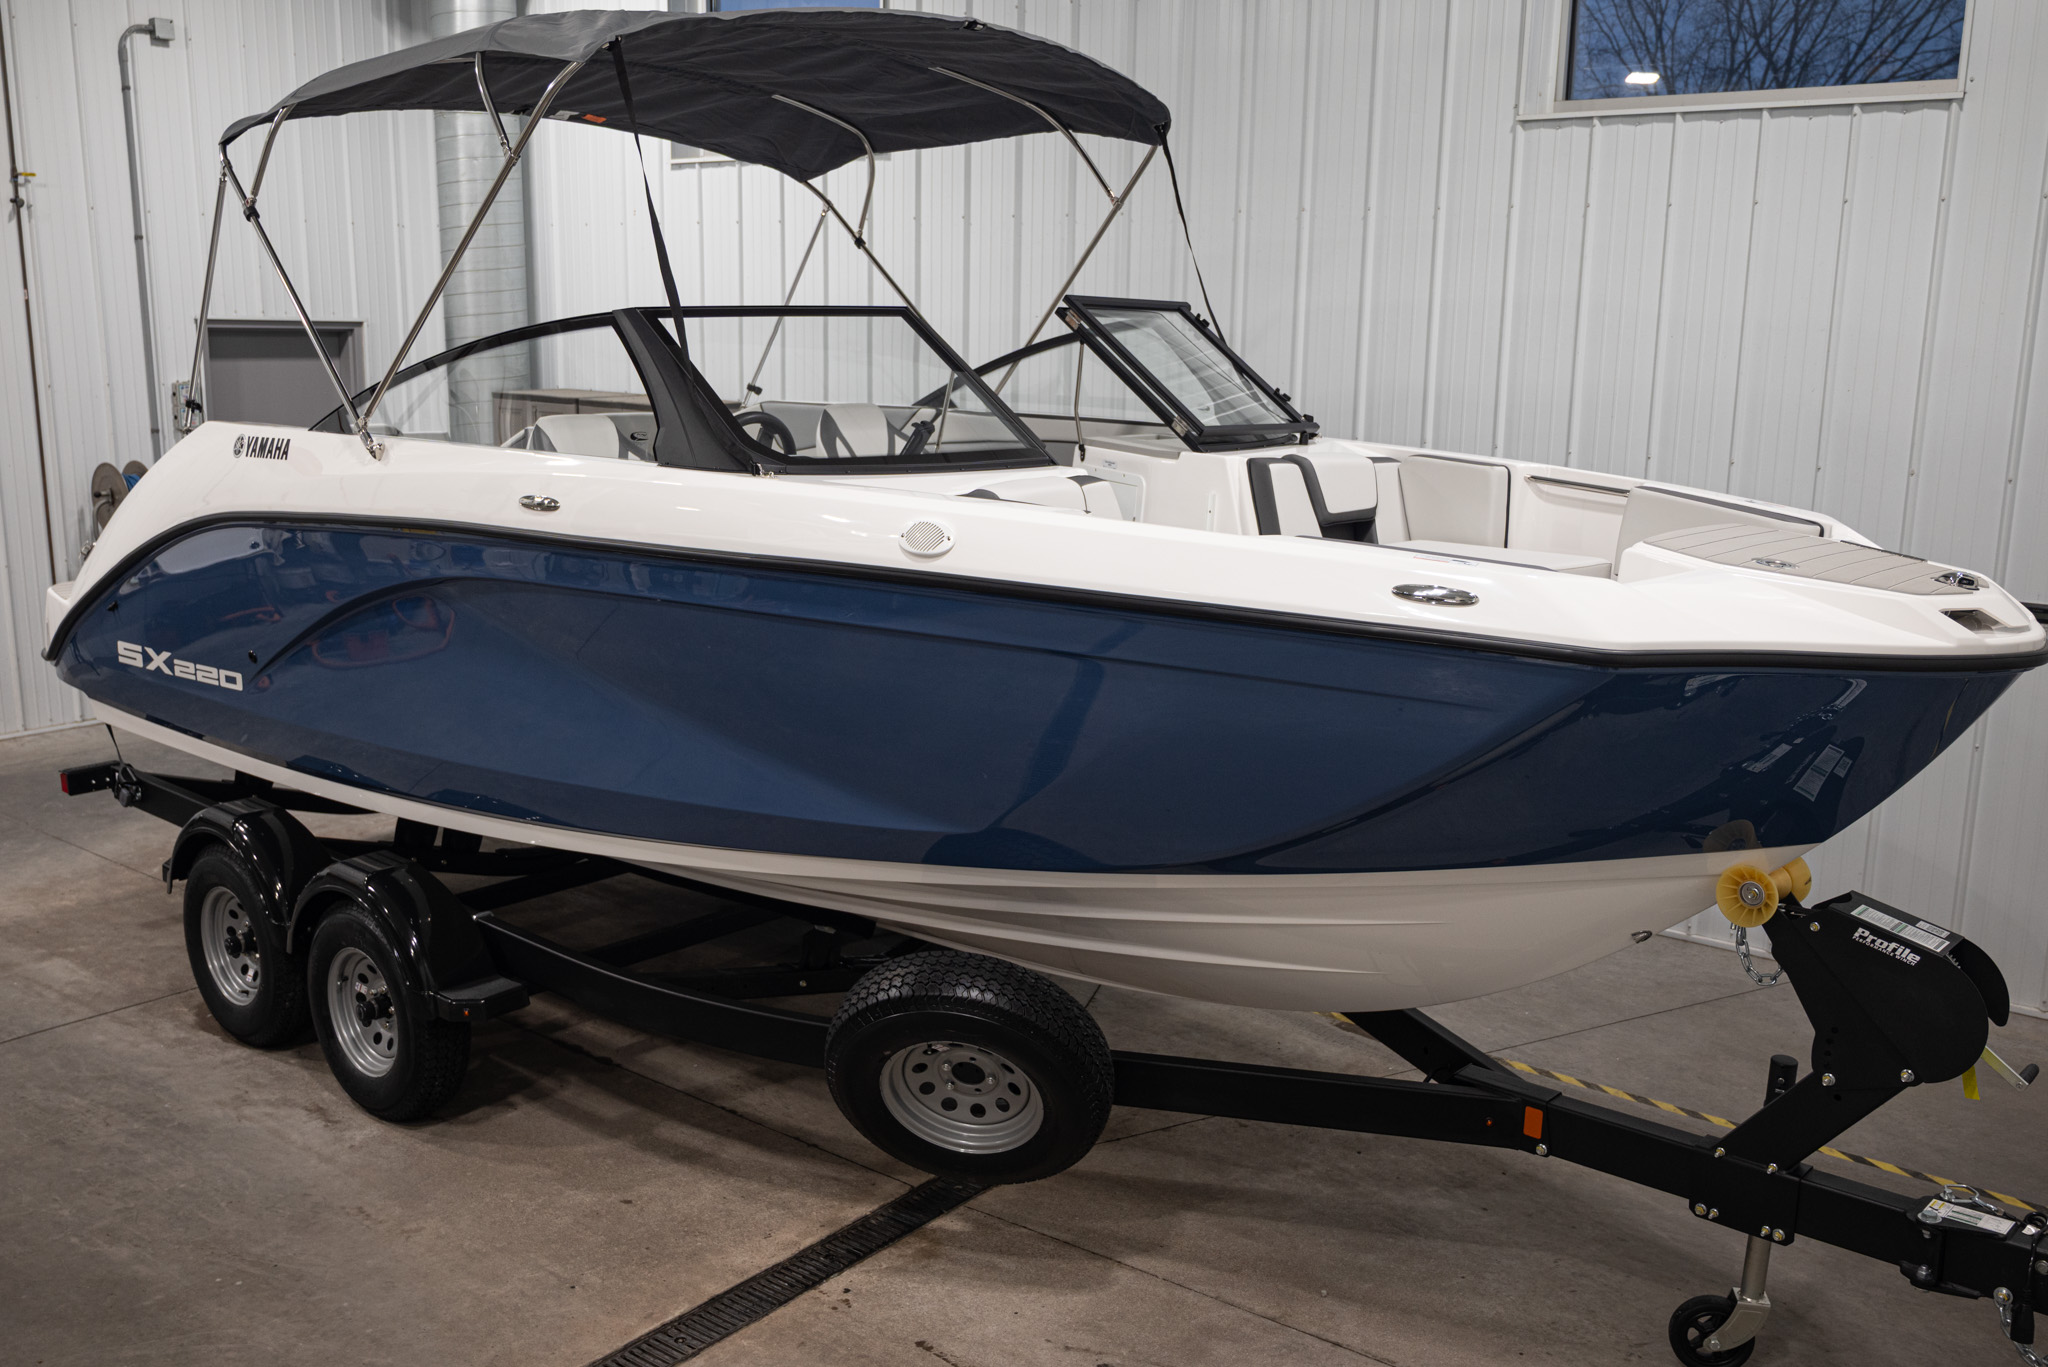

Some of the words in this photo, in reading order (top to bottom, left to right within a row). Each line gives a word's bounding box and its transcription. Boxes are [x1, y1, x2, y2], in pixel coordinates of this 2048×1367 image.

[245, 436, 291, 460] YAMAHA
[117, 640, 243, 691] SX220
[1852, 935, 1894, 957] PERFORMANCE
[1895, 955, 1917, 966] WINCH
[1853, 927, 1921, 964] Profile
